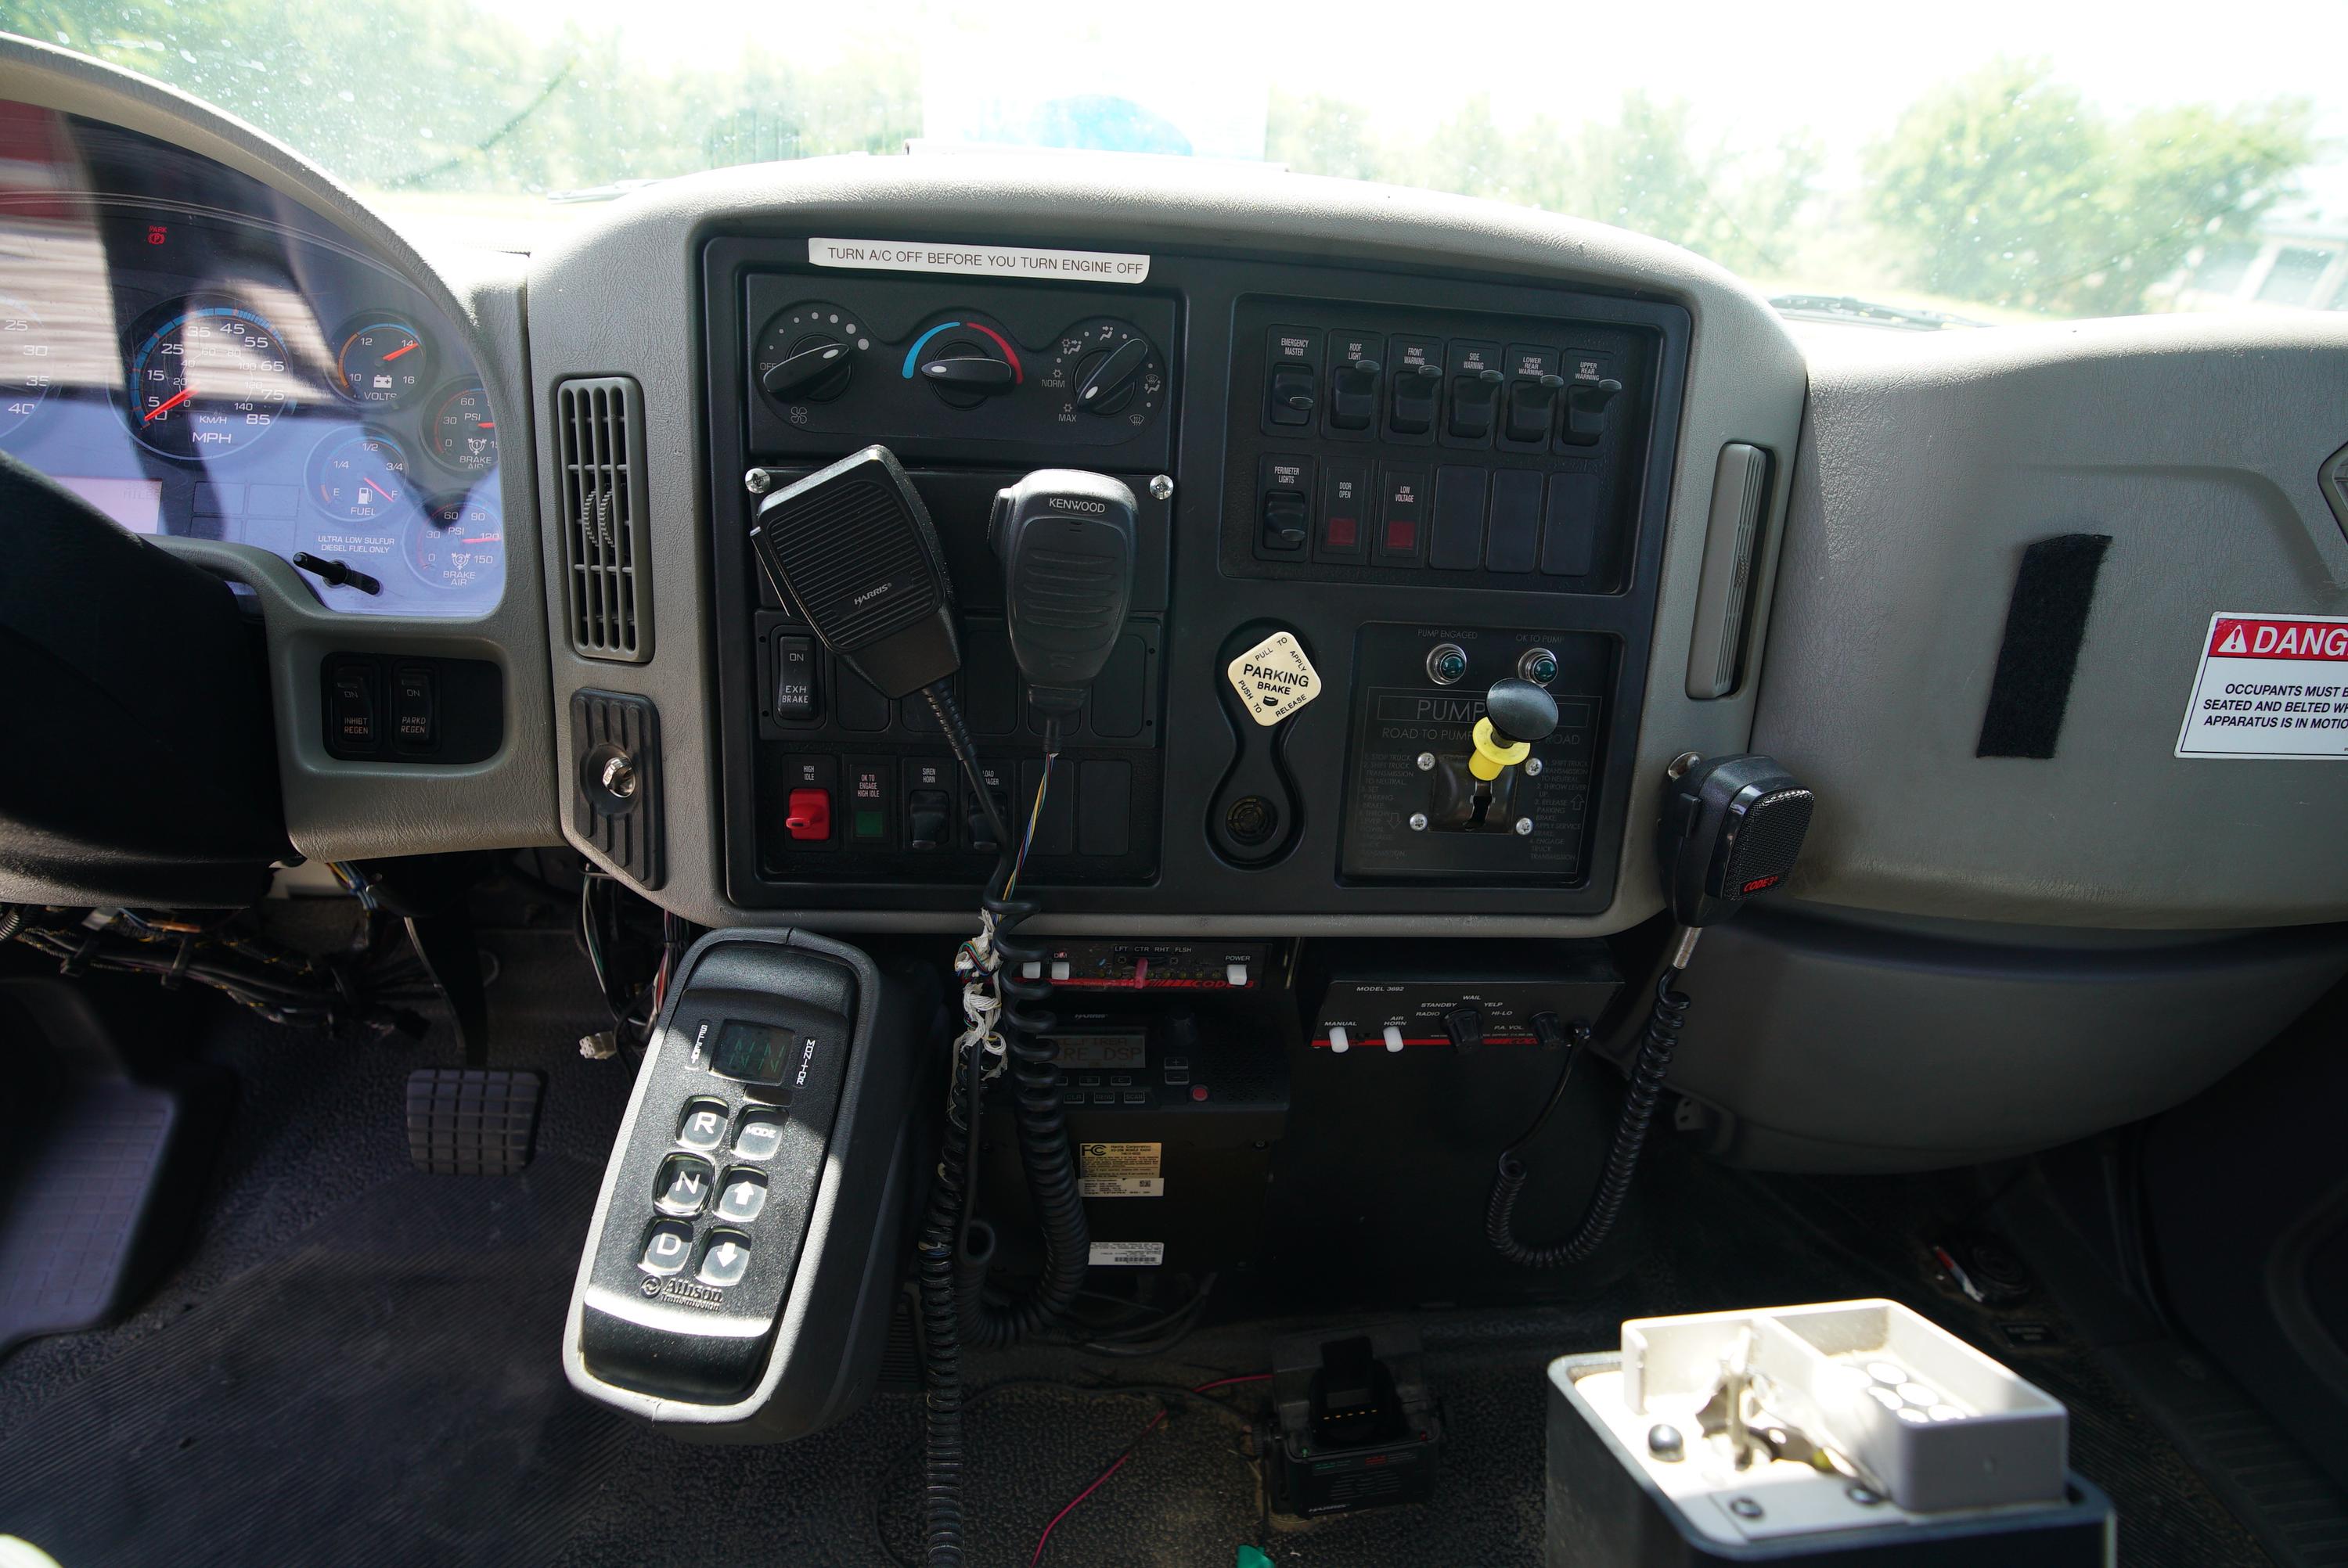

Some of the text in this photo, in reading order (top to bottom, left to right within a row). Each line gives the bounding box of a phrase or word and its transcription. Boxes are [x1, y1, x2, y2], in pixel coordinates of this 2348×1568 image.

[828, 247, 1143, 275] TURN A/C OFF BEFORE YOU TURN ENGINE OFF
[5, 320, 28, 331] 25
[220, 323, 245, 335] 45
[187, 326, 211, 337] 35
[244, 336, 268, 348] 55
[360, 337, 373, 346] 12
[401, 339, 414, 347] 14
[1281, 338, 1309, 347] EMERGENCY
[23, 345, 48, 356] 30
[161, 343, 184, 354] 25
[1284, 347, 1304, 356] MASTER
[1349, 343, 1362, 351] ROOF
[1408, 347, 1423, 356] FRONT
[1404, 356, 1425, 365] WARNING
[1464, 361, 1484, 370] WARNING
[261, 361, 285, 372] 65
[147, 370, 165, 381] 15
[349, 373, 362, 383] 10
[402, 376, 415, 384] 16
[26, 376, 50, 387] 35
[173, 377, 188, 386] 20
[1041, 379, 1065, 389] NORM
[261, 389, 285, 401] 75
[364, 391, 397, 401] VOLTS
[148, 397, 160, 407] 5
[8, 404, 34, 415] 40
[200, 415, 227, 424] KM/H
[246, 414, 271, 426] 85
[443, 416, 457, 425] 30
[464, 413, 481, 422] PSI
[1058, 413, 1077, 423] MAX
[193, 432, 232, 444] MPH
[362, 443, 379, 451] 1/2
[333, 460, 350, 469] 1/4
[459, 455, 492, 464] BRAKE
[386, 462, 403, 471] 3/4
[1274, 466, 1299, 475] PERIMETER
[1339, 482, 1352, 491] DOOR
[1395, 494, 1414, 503] VOLTAGE
[1049, 498, 1105, 512] KENWOOD
[351, 507, 376, 516] FUEL
[470, 512, 485, 521] 90
[427, 530, 441, 539] 30
[318, 535, 344, 544] ULTRA
[364, 537, 395, 545] SULFUR
[321, 544, 390, 554] DIESEL FUEL ONLY
[474, 556, 493, 564] 150
[443, 570, 475, 580] BRAKE
[854, 584, 889, 608] HARRIS
[1417, 629, 1478, 640] PUMP ENGAGED
[2253, 626, 2348, 656] DANG
[1255, 637, 1307, 672] PULL TO APPLY
[1243, 664, 1309, 688] PARKING
[1257, 682, 1291, 695] BRAKE
[2225, 683, 2341, 697] OCCUPANTS MUST
[782, 695, 808, 703] BRAKE
[1238, 680, 1307, 717] PUSH TO RELEASE
[1417, 699, 1486, 721] PUMP
[2203, 699, 2330, 713] SEATED AND BELTED
[2204, 715, 2348, 729] APPARATUS IS IN MOTIO
[344, 726, 369, 735] REGEN
[1382, 727, 1473, 741] ROAD TO PUMP
[859, 782, 877, 790] ENGAGE
[691, 1025, 708, 1064] SELECT
[796, 1038, 816, 1086] MONITOR
[693, 1112, 717, 1135] R
[745, 1125, 776, 1139] MODE
[675, 1171, 700, 1195] N
[656, 1232, 682, 1254] D
[663, 1278, 722, 1303] Allison
